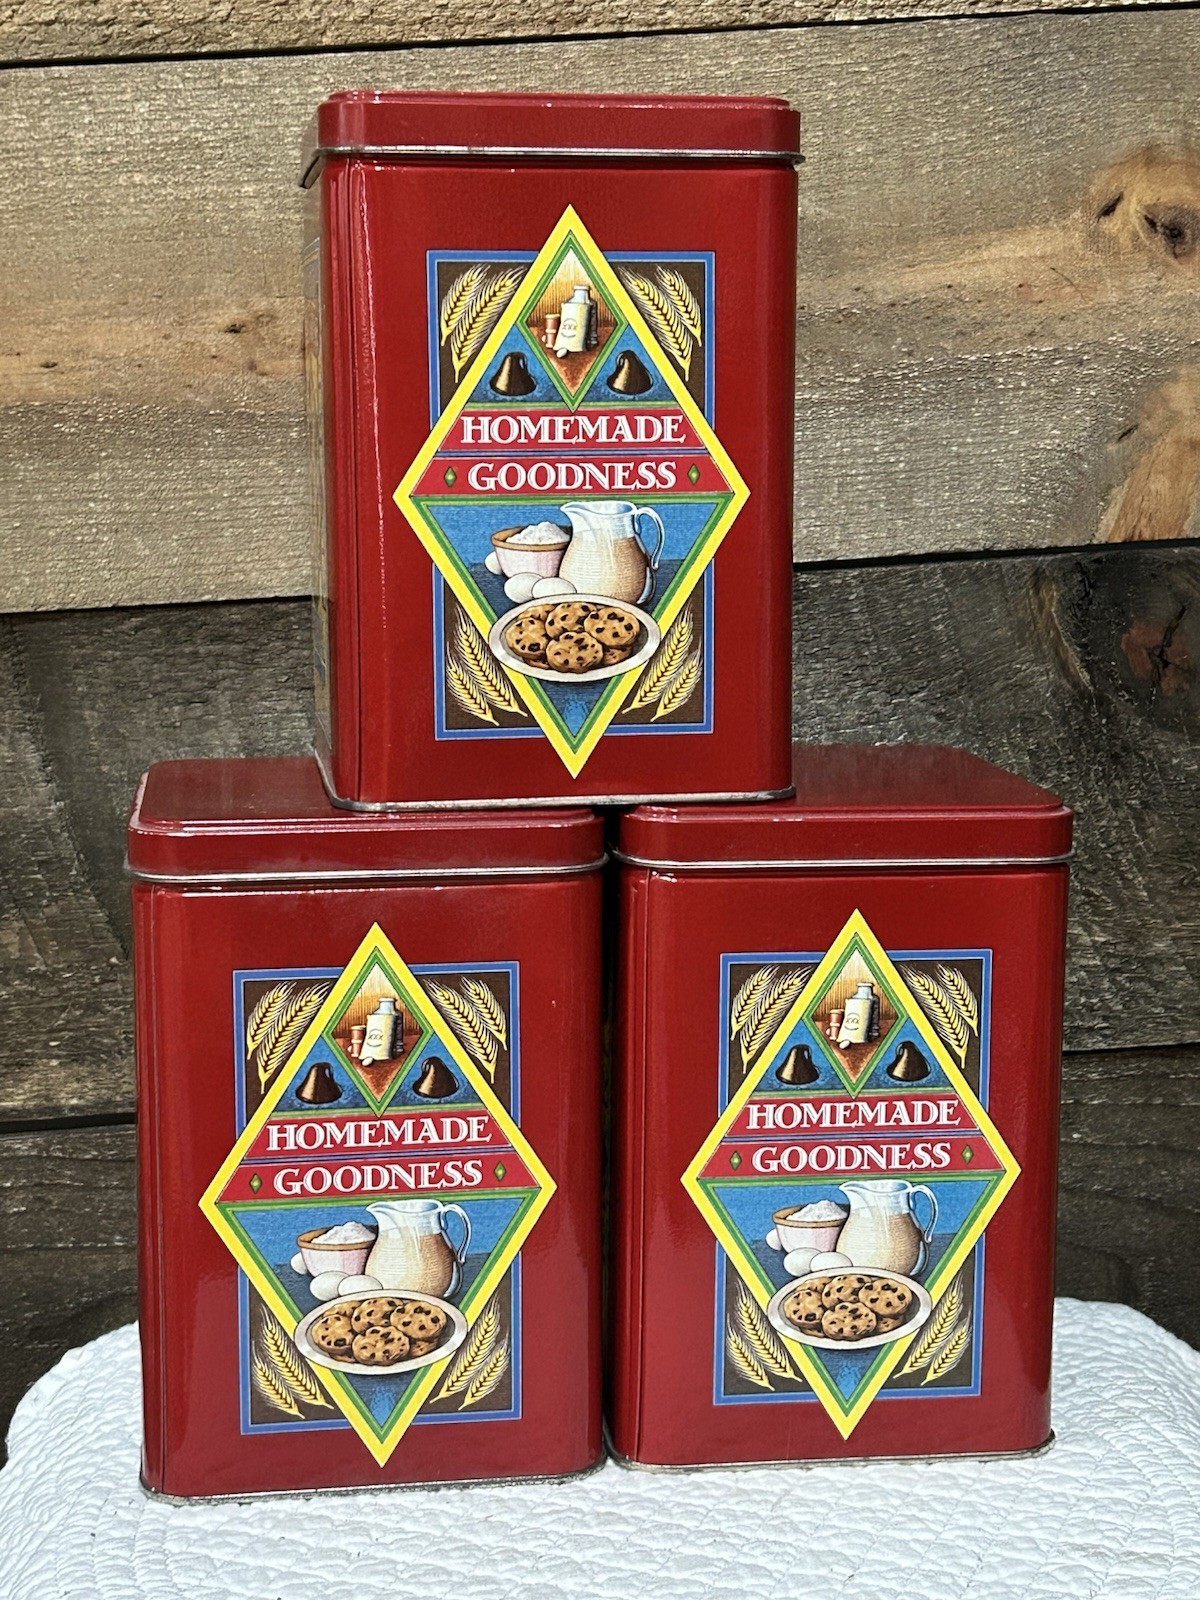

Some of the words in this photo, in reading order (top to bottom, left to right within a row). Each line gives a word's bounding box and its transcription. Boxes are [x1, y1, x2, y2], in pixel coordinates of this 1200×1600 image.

[460, 415, 686, 444] HOMEMADE
[468, 461, 676, 491] GOODNESS
[746, 1099, 961, 1129] HOMEMADE
[266, 1116, 491, 1151] HOMEMADE
[752, 1142, 951, 1172] GOODNESS
[274, 1160, 483, 1195] GOODNESS
